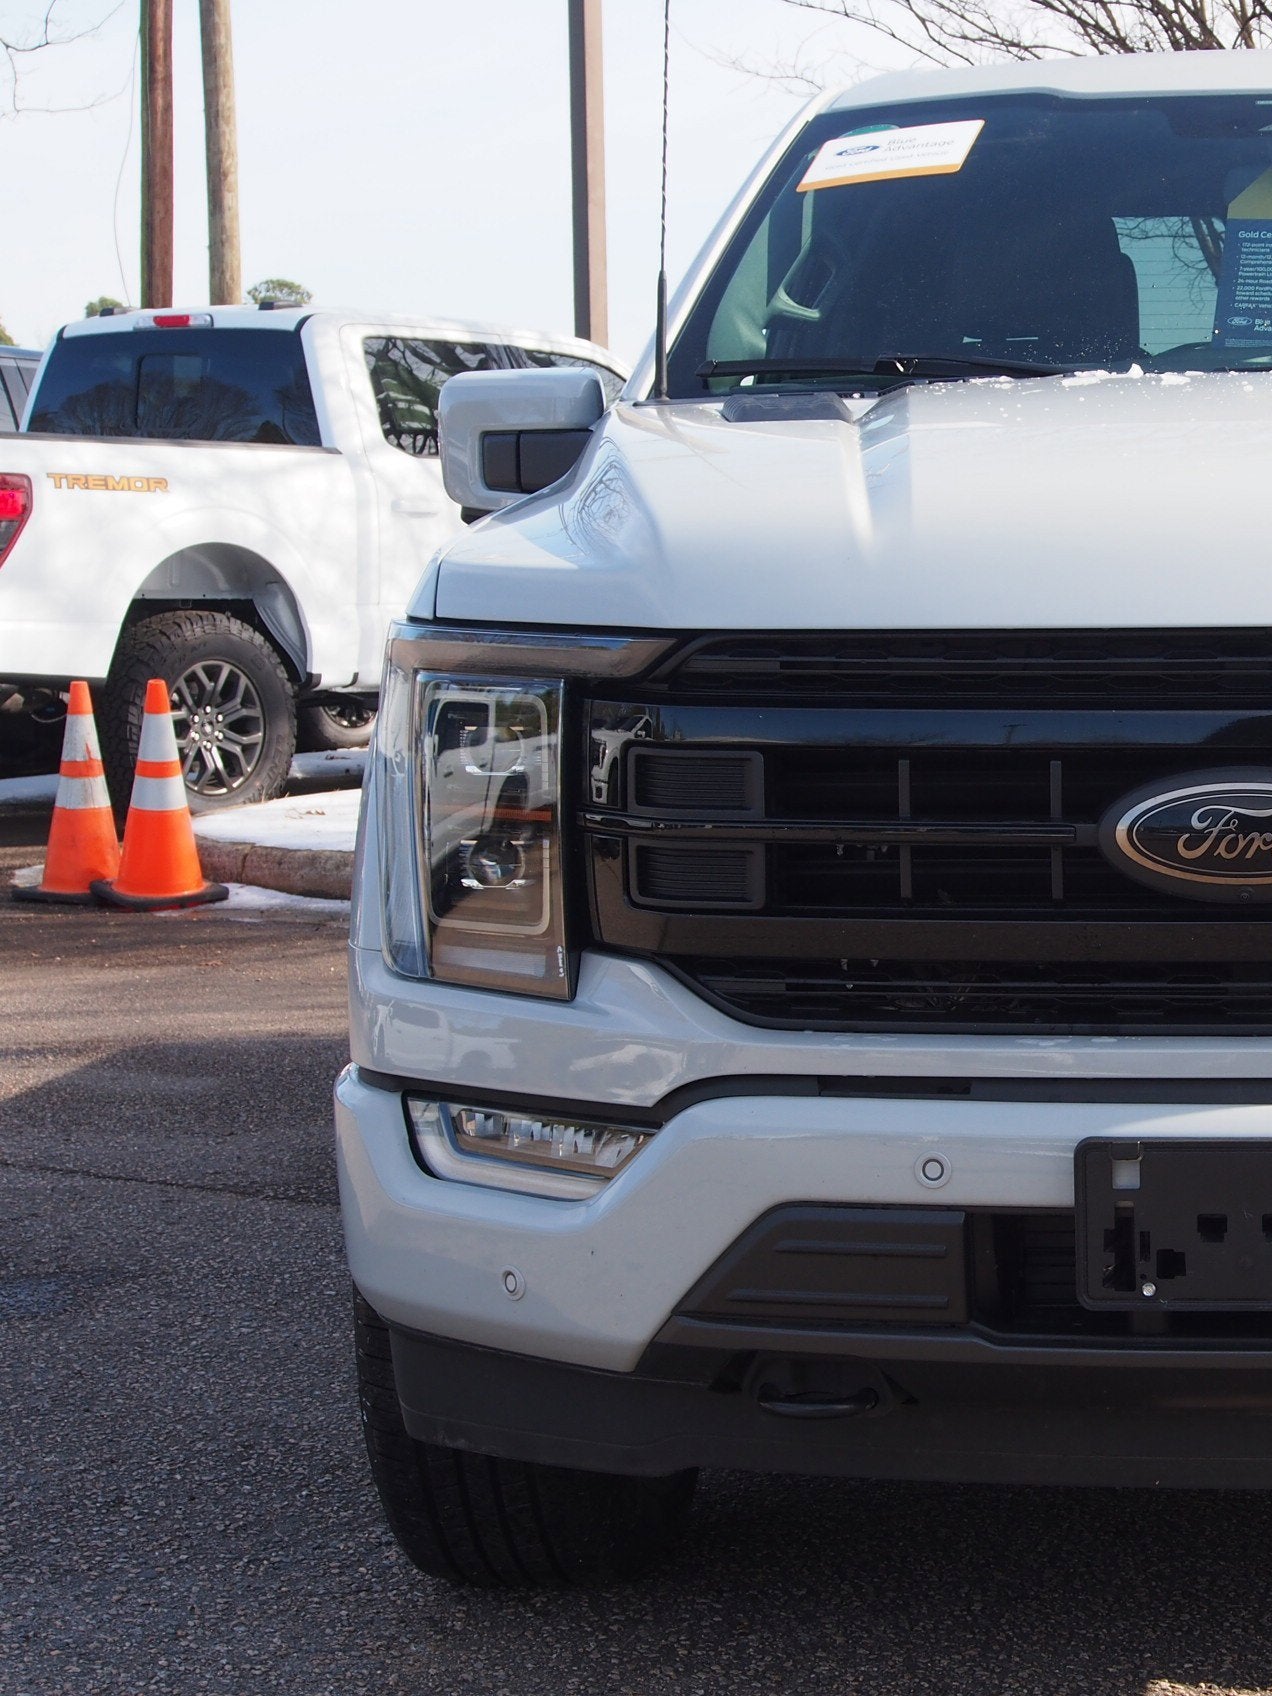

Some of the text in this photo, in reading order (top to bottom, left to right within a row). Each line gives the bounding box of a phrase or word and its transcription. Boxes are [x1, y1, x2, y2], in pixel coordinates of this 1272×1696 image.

[884, 139, 955, 152] Advantage
[1238, 230, 1259, 239] Gold
[46, 472, 170, 493] TREMOR
